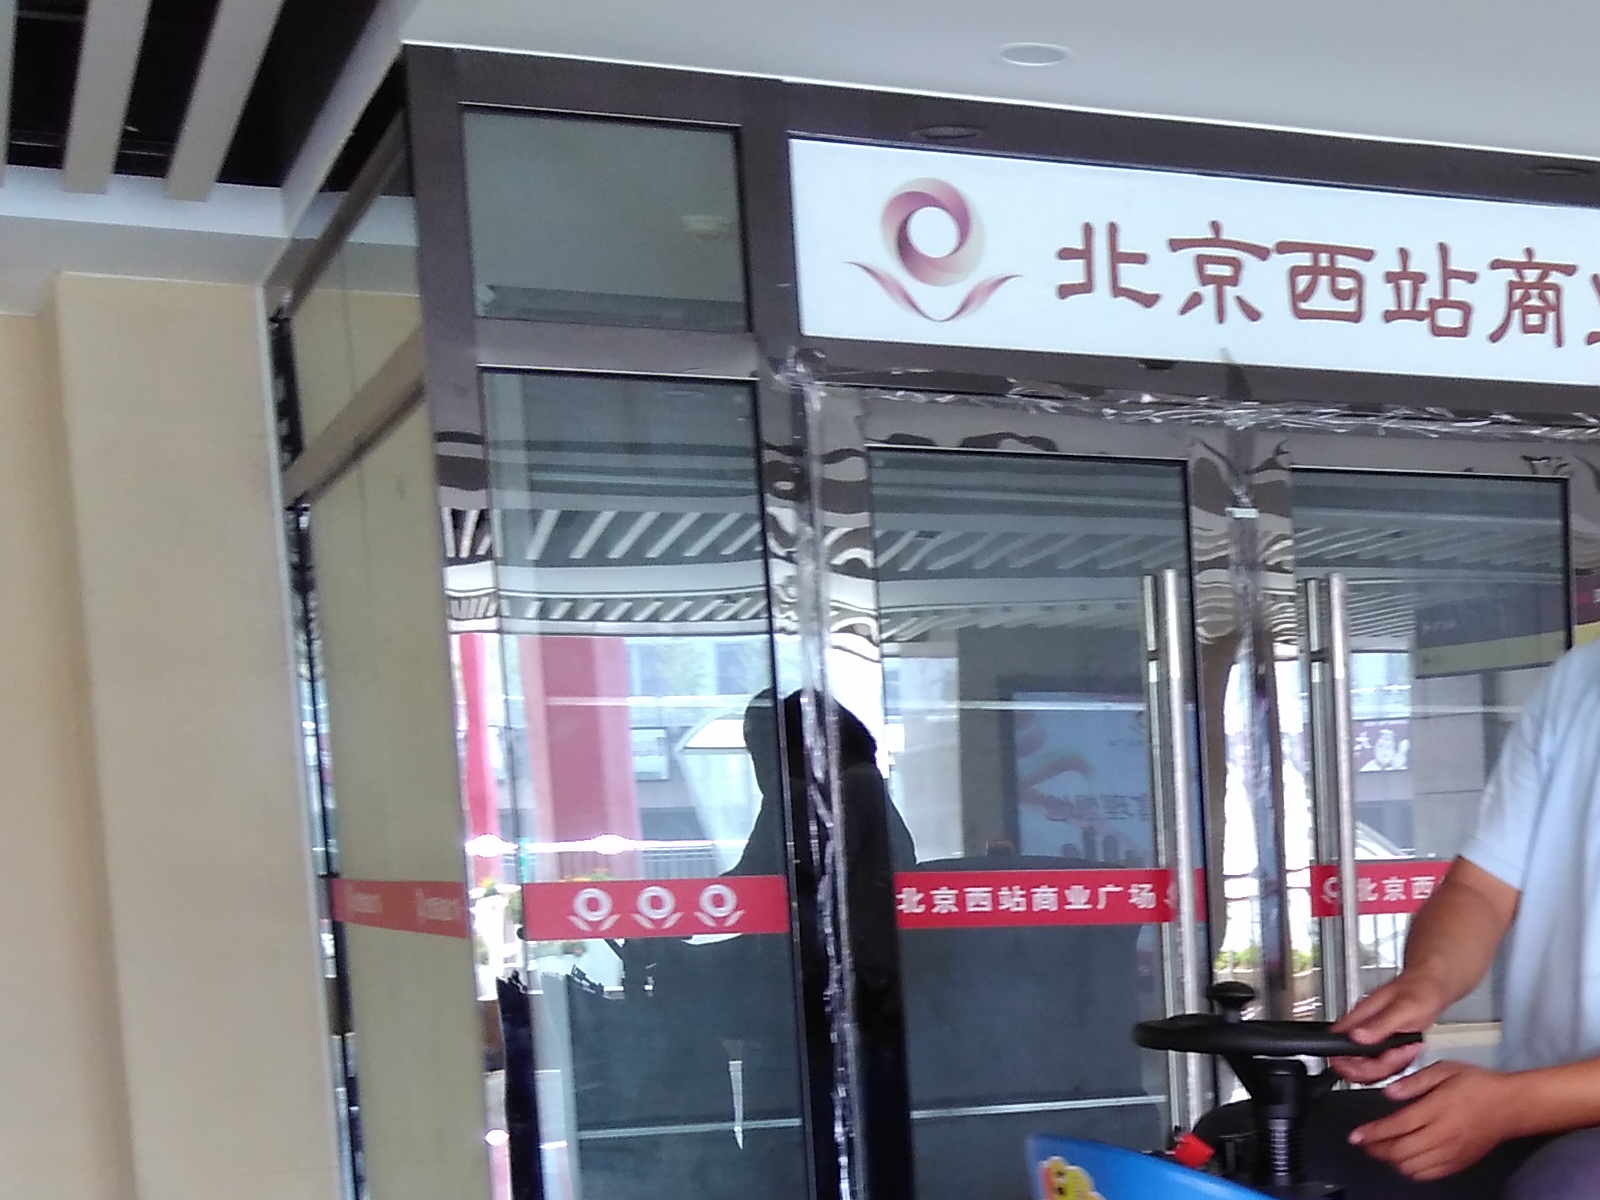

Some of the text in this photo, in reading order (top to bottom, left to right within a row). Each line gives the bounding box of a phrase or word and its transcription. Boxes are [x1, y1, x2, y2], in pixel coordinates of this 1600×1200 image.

[896, 884, 1156, 914] 北京西站商业广场
[1357, 876, 1446, 902] 北京西
